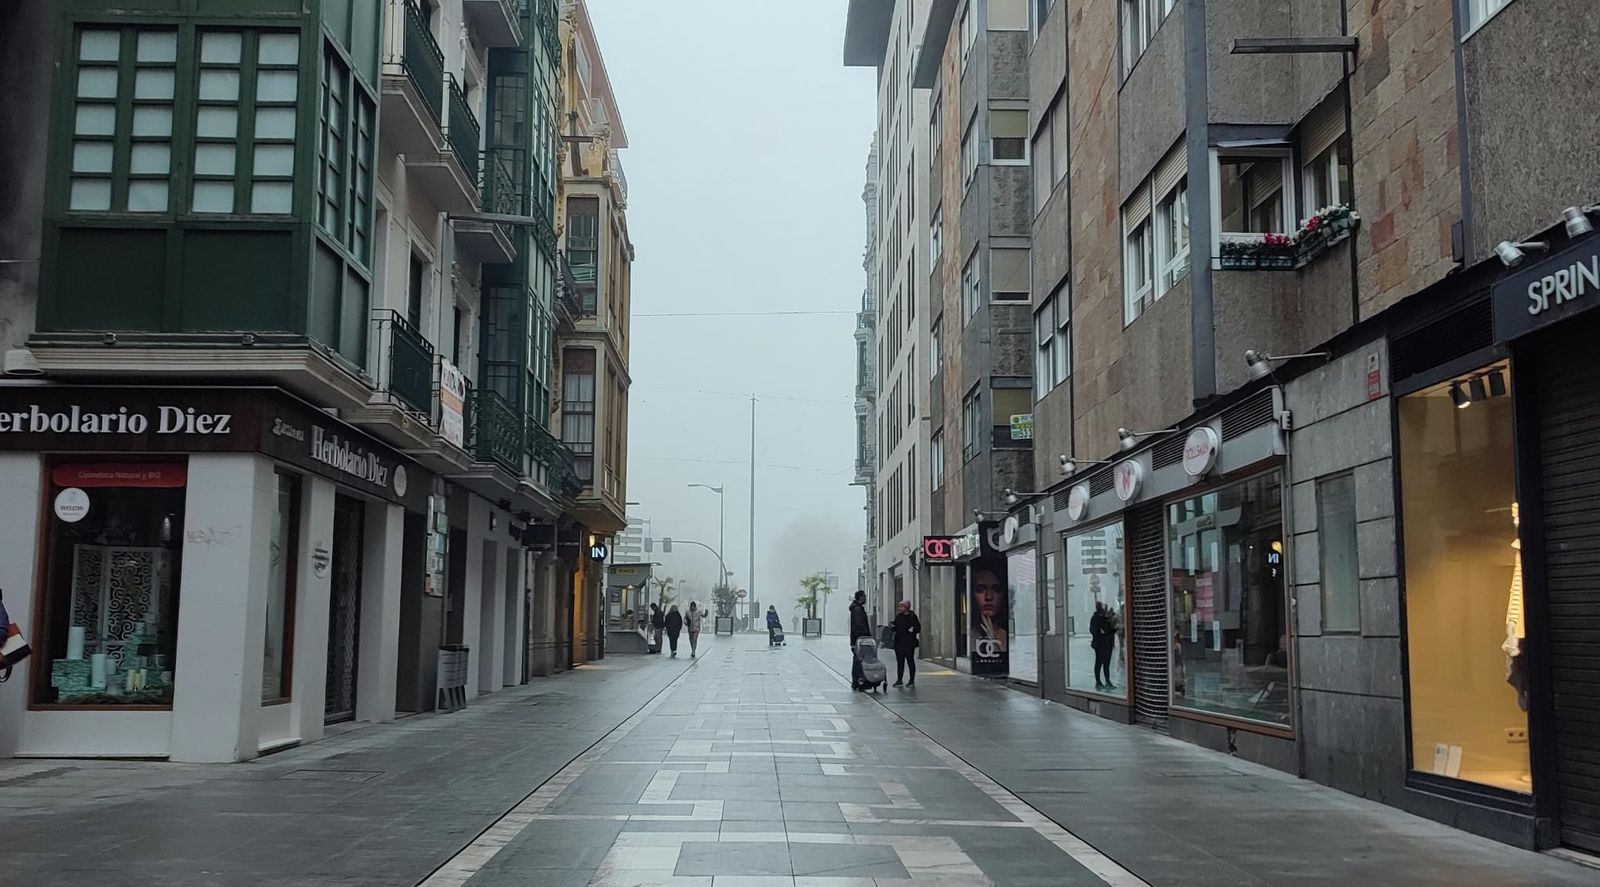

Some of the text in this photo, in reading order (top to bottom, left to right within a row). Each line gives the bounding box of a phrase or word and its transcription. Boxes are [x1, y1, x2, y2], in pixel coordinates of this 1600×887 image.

[1528, 255, 1600, 315] SPRIN
[0, 405, 232, 434] erbolario Diez
[310, 424, 367, 479] Herbolario
[367, 451, 388, 488] Diez
[147, 471, 161, 479] BIO
[591, 547, 605, 558] IN
